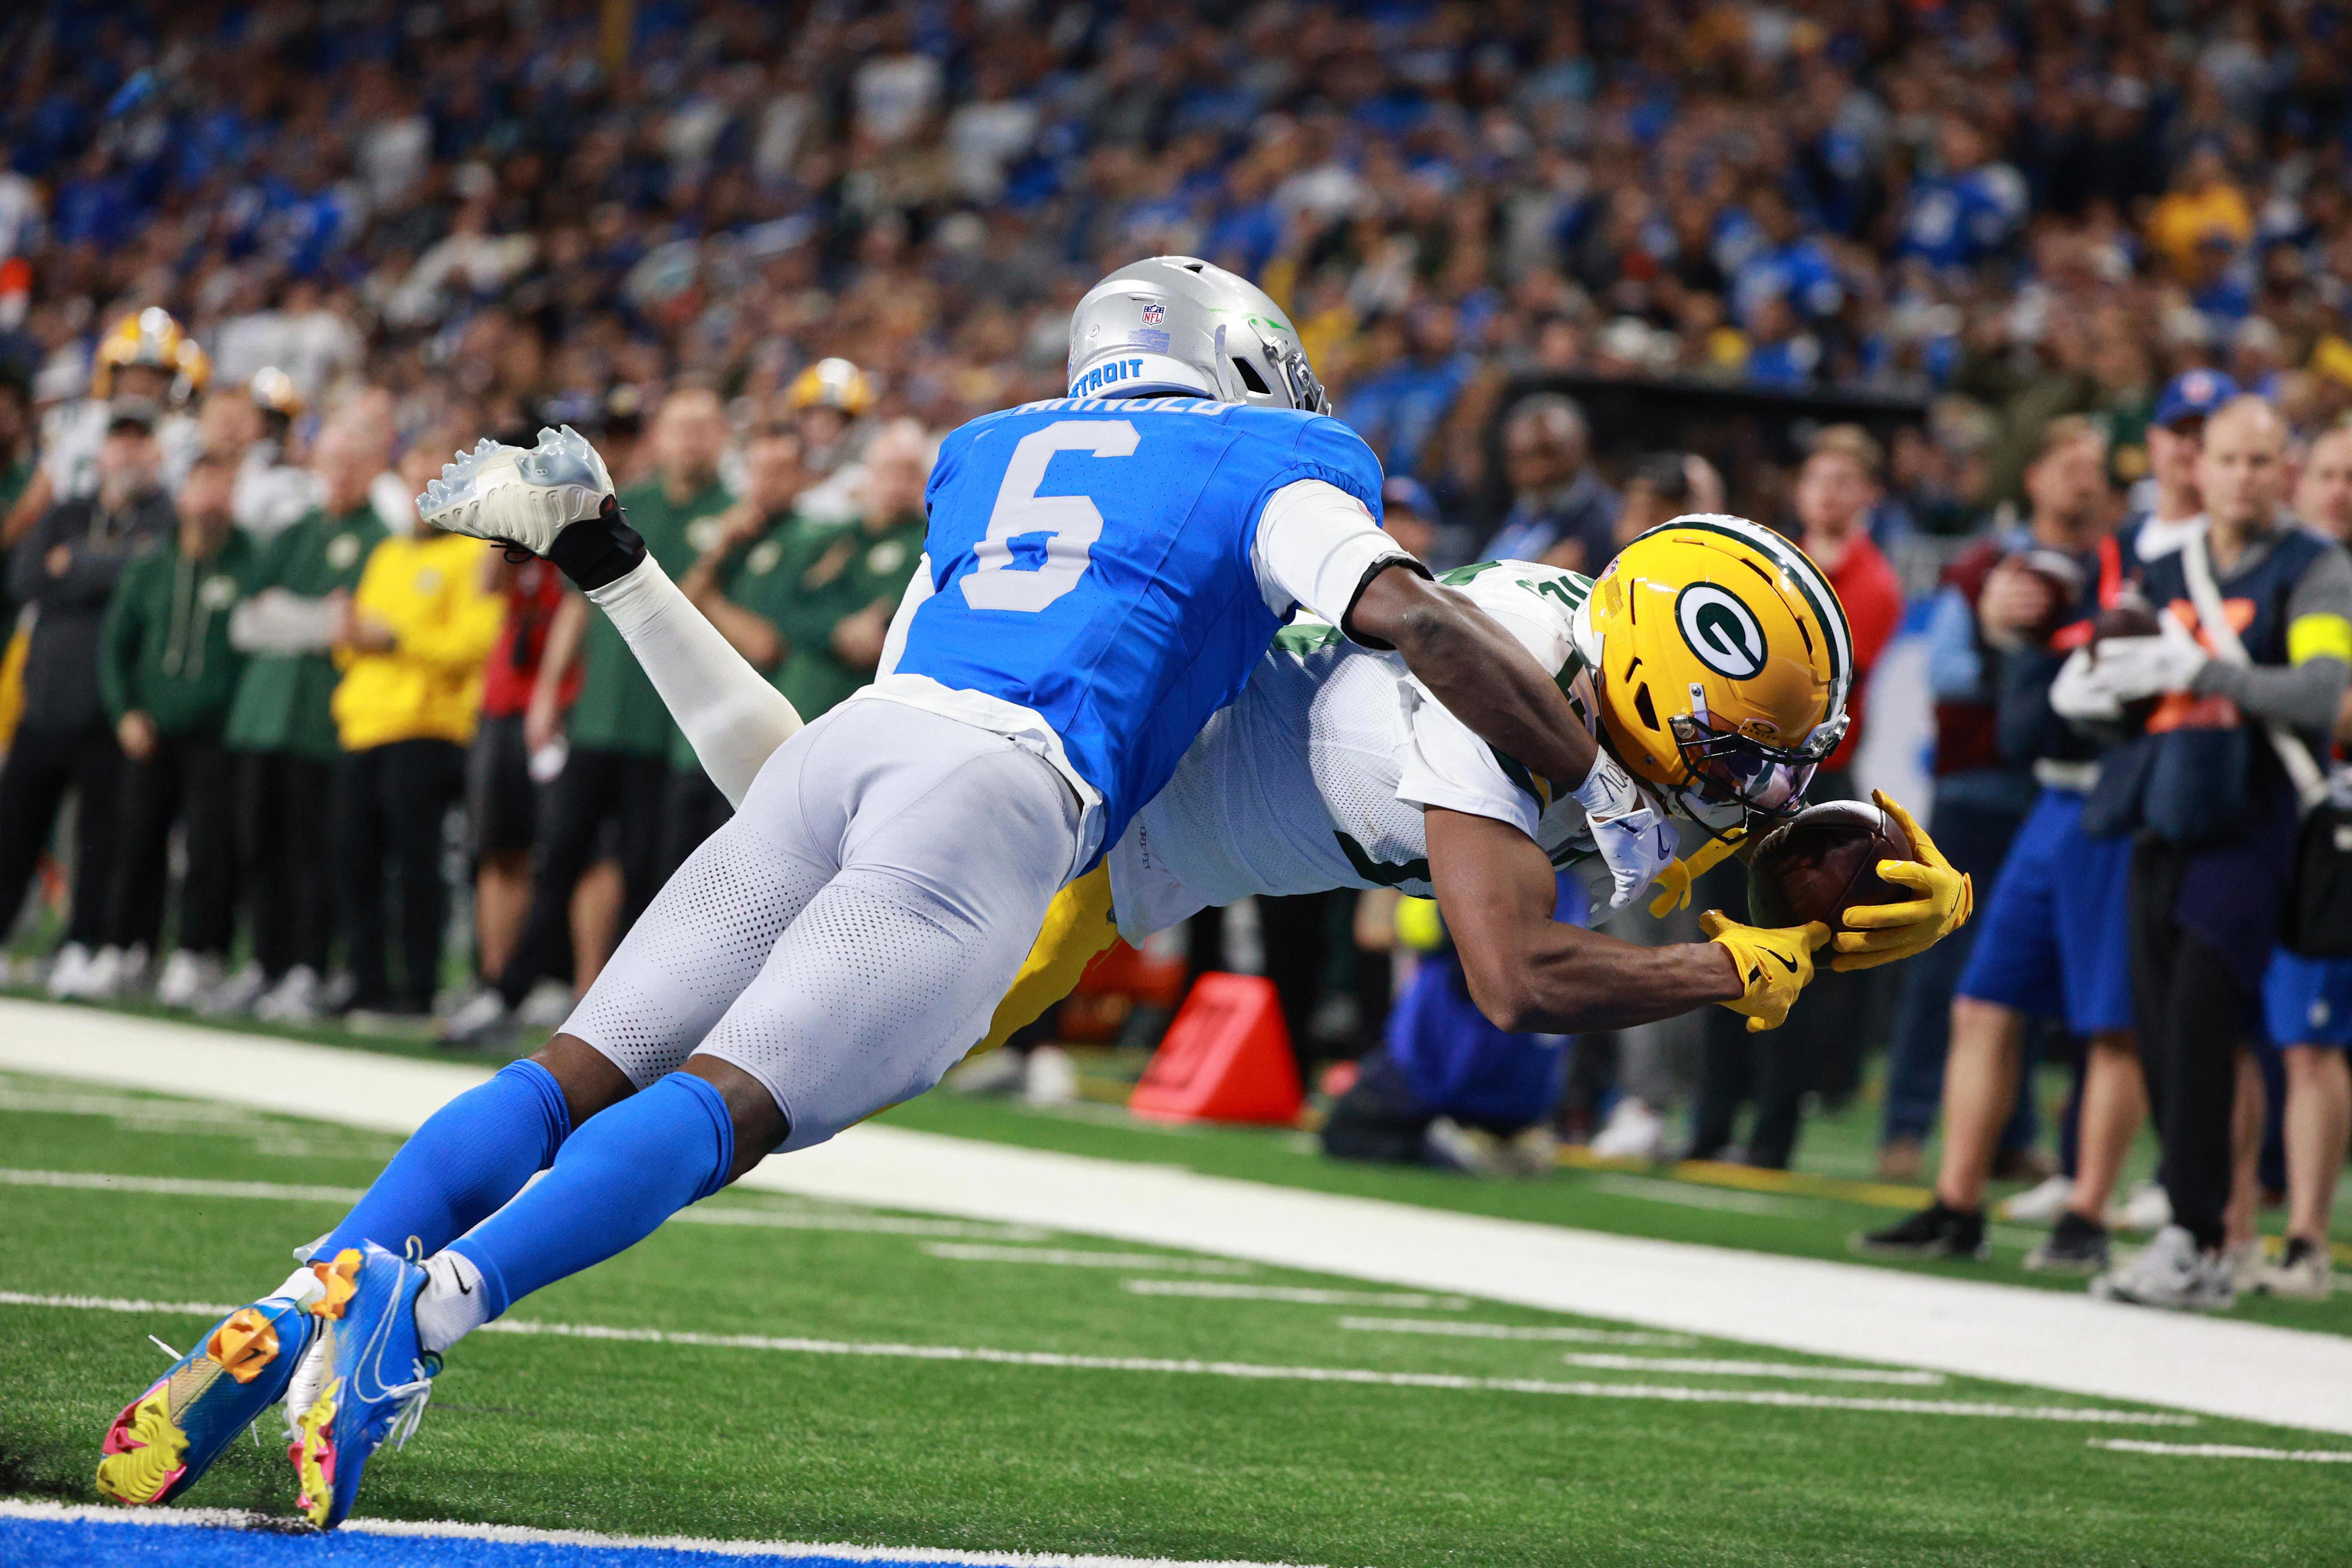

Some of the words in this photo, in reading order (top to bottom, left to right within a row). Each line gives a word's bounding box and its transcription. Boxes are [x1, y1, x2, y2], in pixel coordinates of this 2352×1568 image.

[1144, 313, 1160, 323] NFL
[1068, 359, 1143, 398] ETROIT
[958, 420, 1141, 613] 6
[1678, 584, 1764, 678] G
